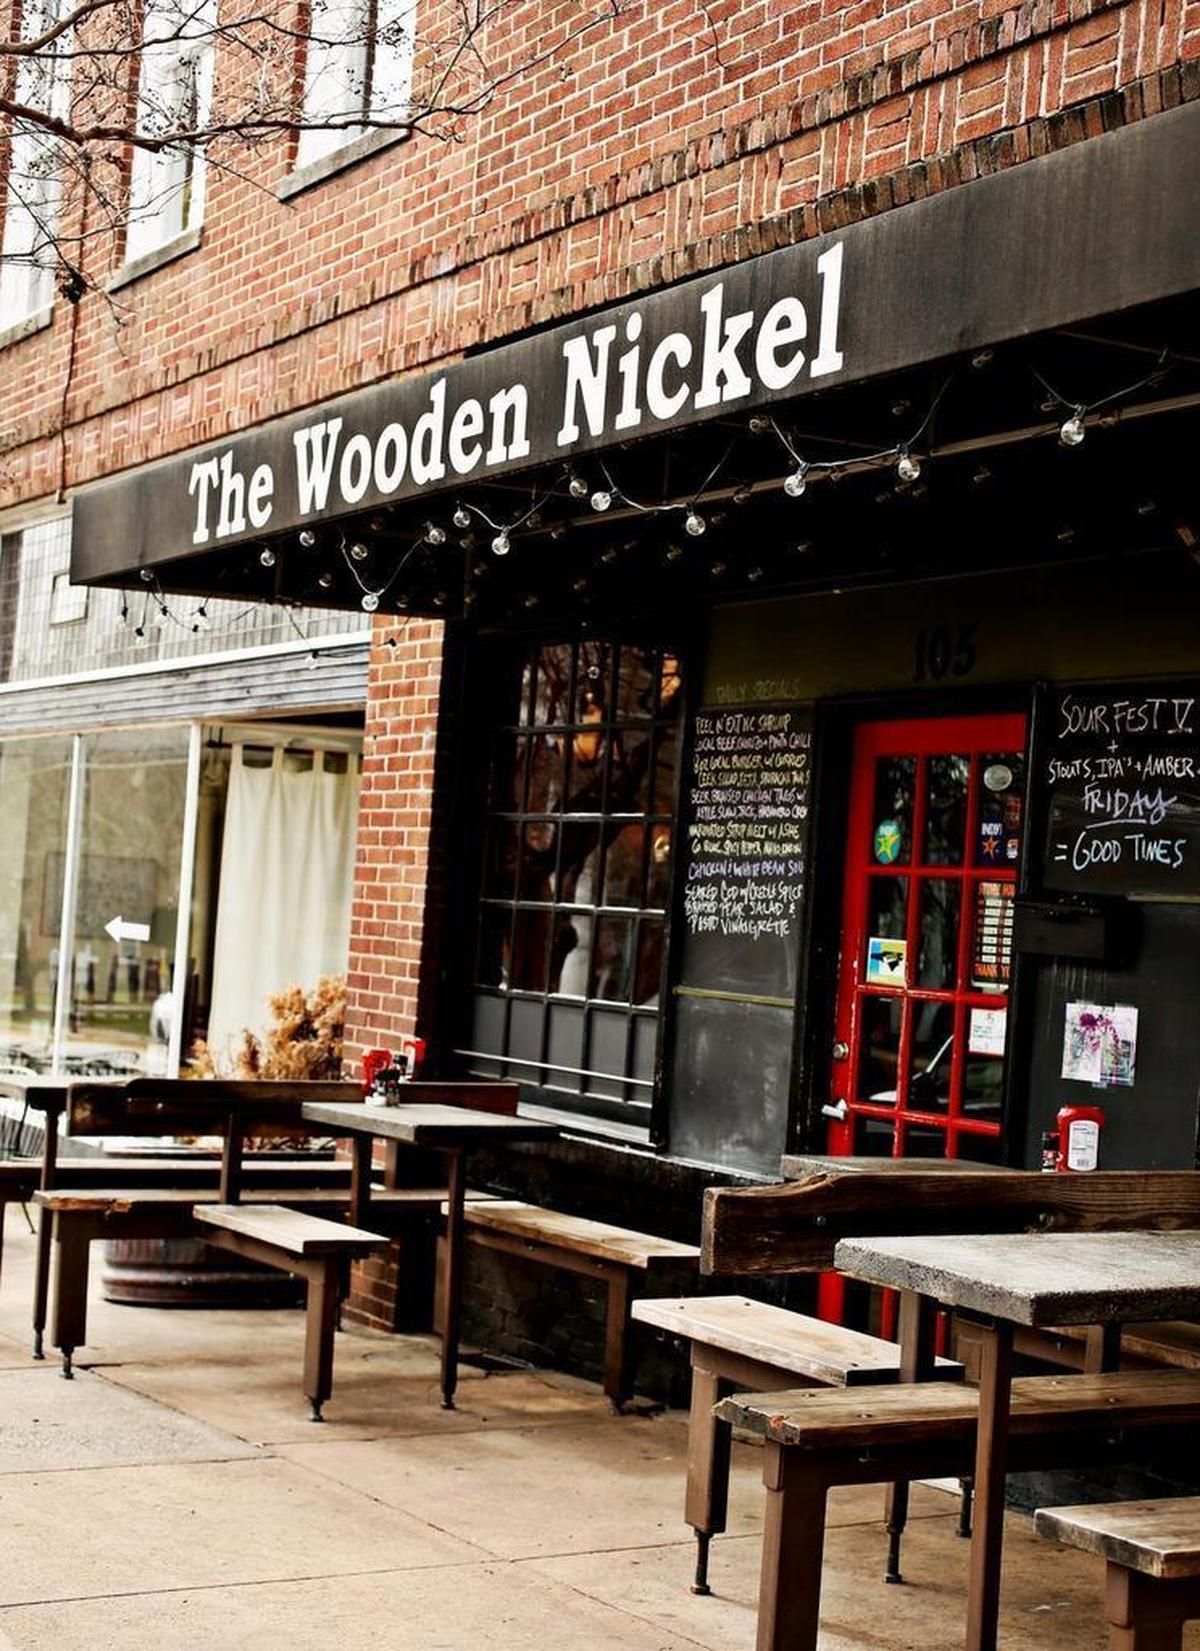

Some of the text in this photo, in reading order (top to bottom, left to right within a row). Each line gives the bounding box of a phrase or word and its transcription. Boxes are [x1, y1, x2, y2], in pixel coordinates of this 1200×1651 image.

[188, 240, 844, 546] The Wooden Nickel
[914, 622, 979, 682] 105
[1083, 781, 1178, 825] FRIDAY
[1073, 831, 1121, 870] GOOD
[1124, 834, 1187, 869] TIMES
[750, 900, 784, 916] SALAD
